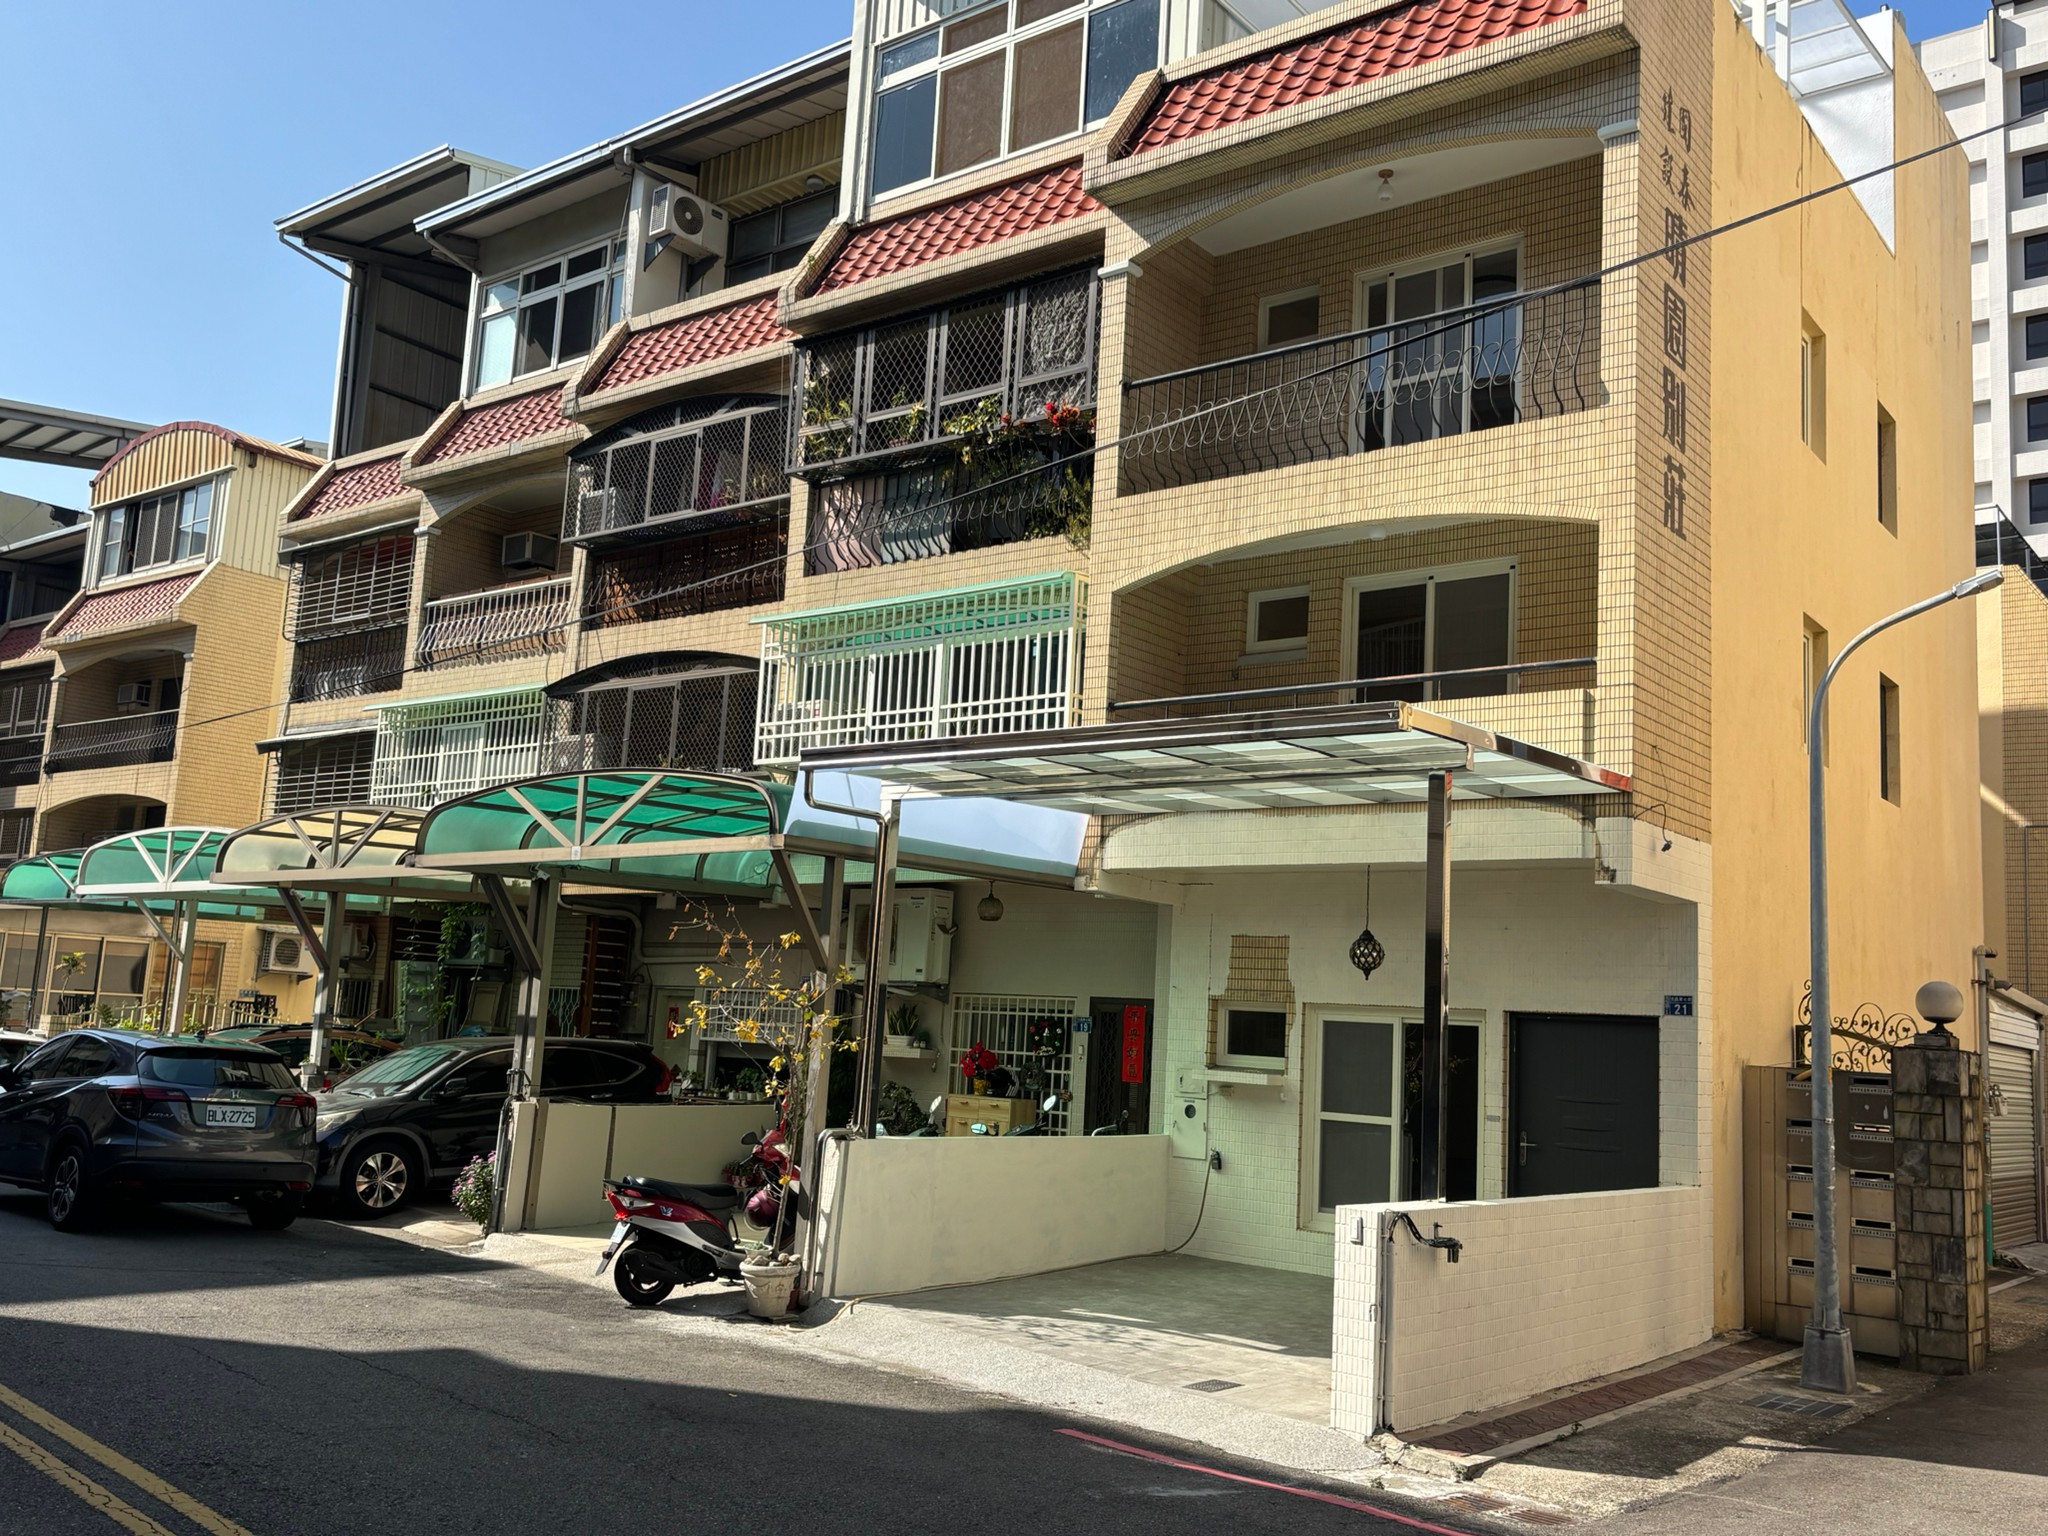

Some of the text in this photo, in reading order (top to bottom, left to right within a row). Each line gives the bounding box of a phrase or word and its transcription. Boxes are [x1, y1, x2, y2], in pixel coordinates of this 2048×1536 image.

[1662, 206, 1687, 541] 晴園別莊
[1674, 1003, 1687, 1015] 21
[207, 1109, 255, 1124] BLX-2725
